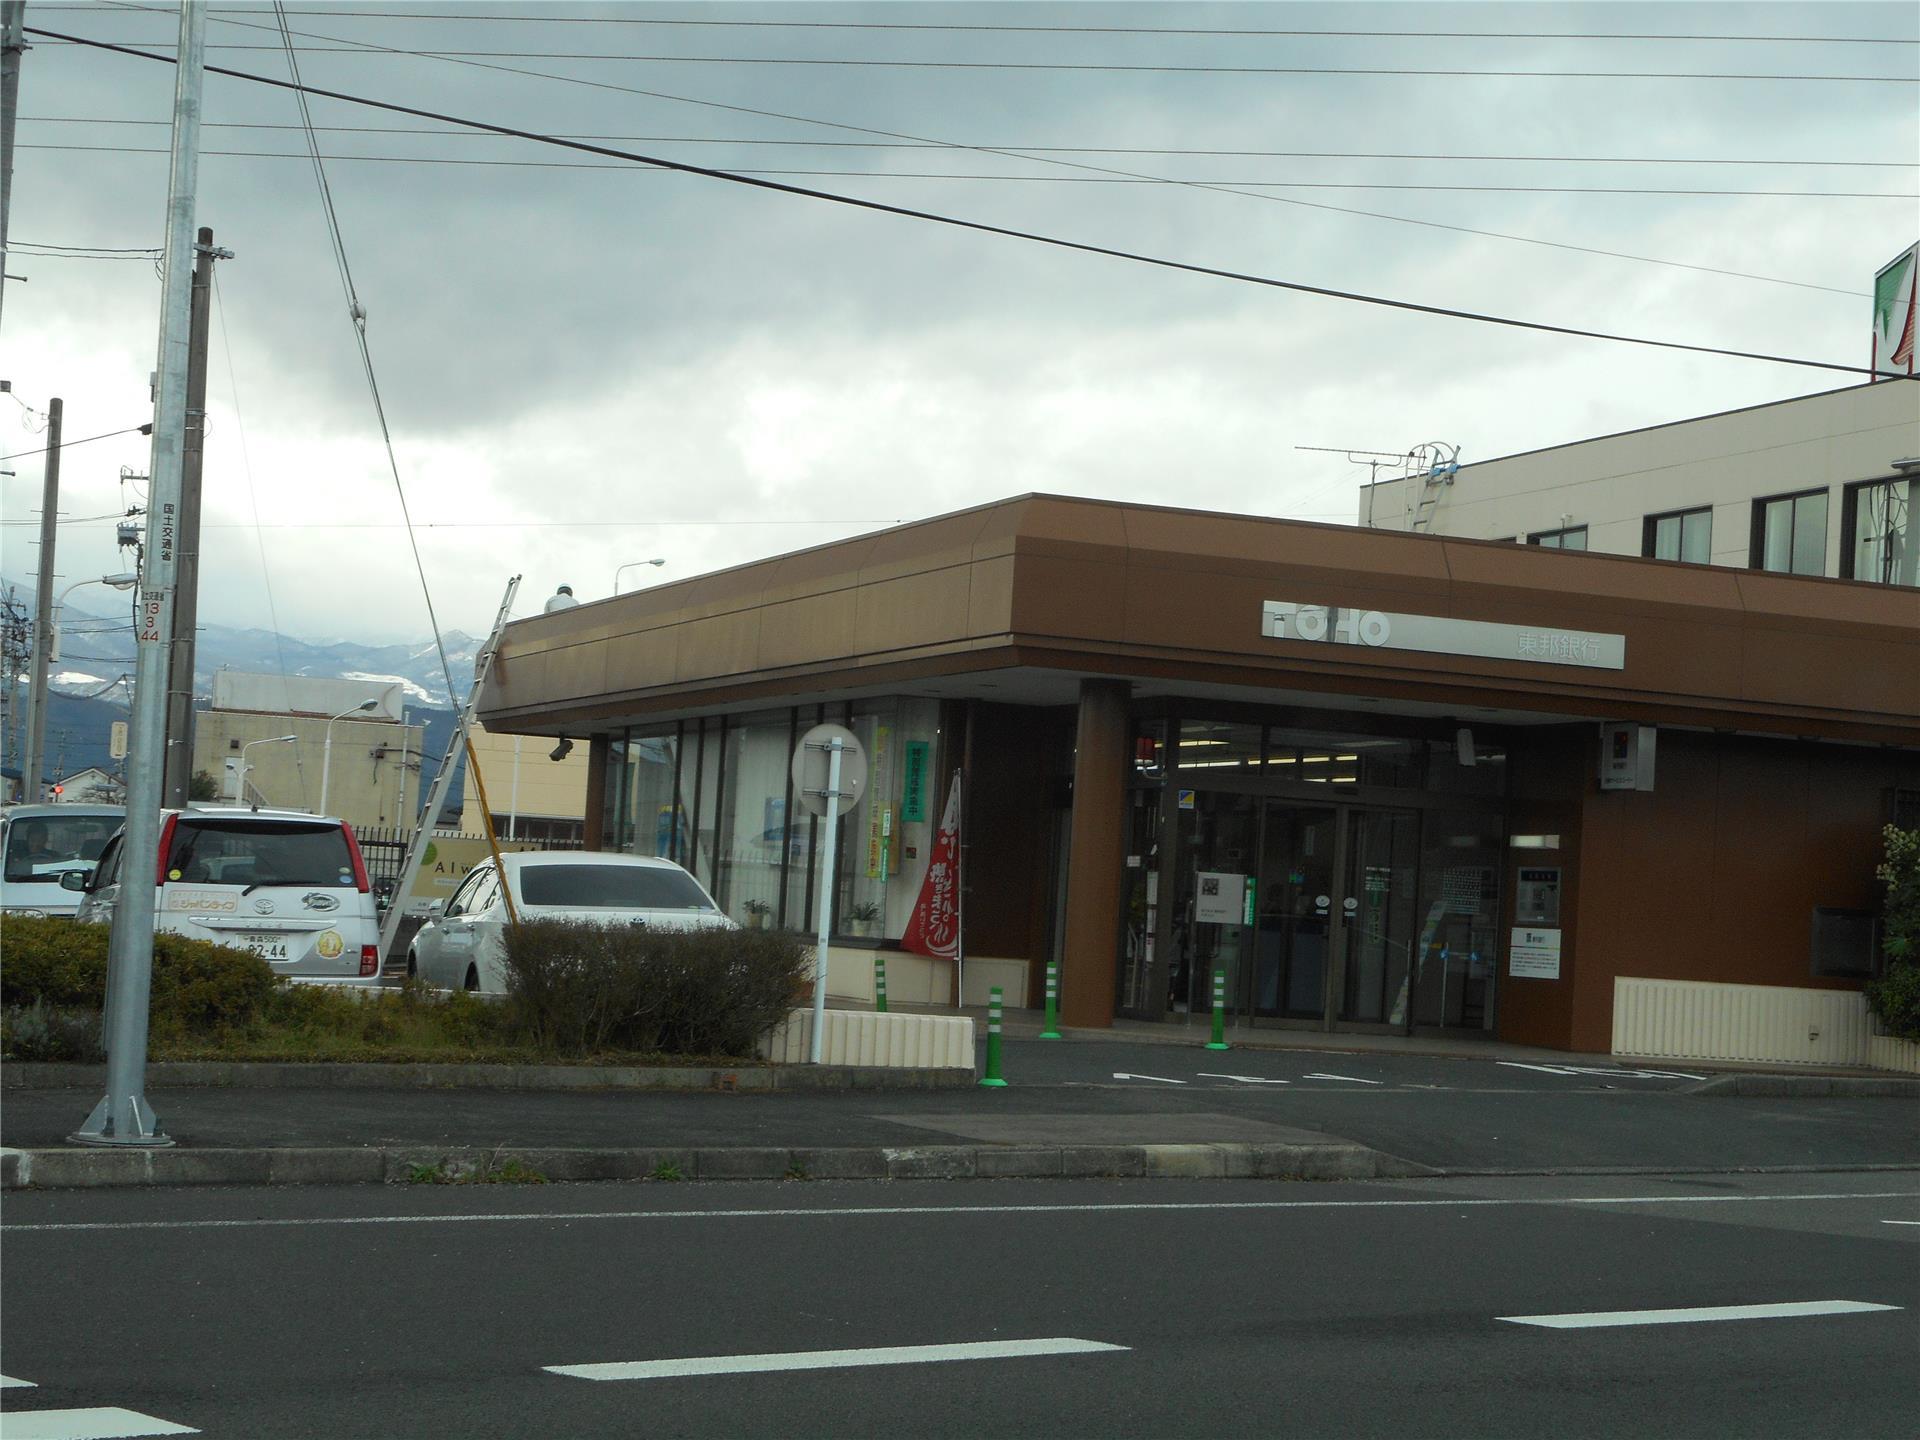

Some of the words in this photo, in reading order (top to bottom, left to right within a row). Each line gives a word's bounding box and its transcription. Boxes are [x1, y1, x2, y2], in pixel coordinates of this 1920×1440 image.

[161, 503, 175, 562] 国土交通省
[144, 602, 160, 615] 13
[145, 616, 155, 629] 3
[141, 630, 159, 642] 44
[1516, 631, 1602, 662] 東邦銀行
